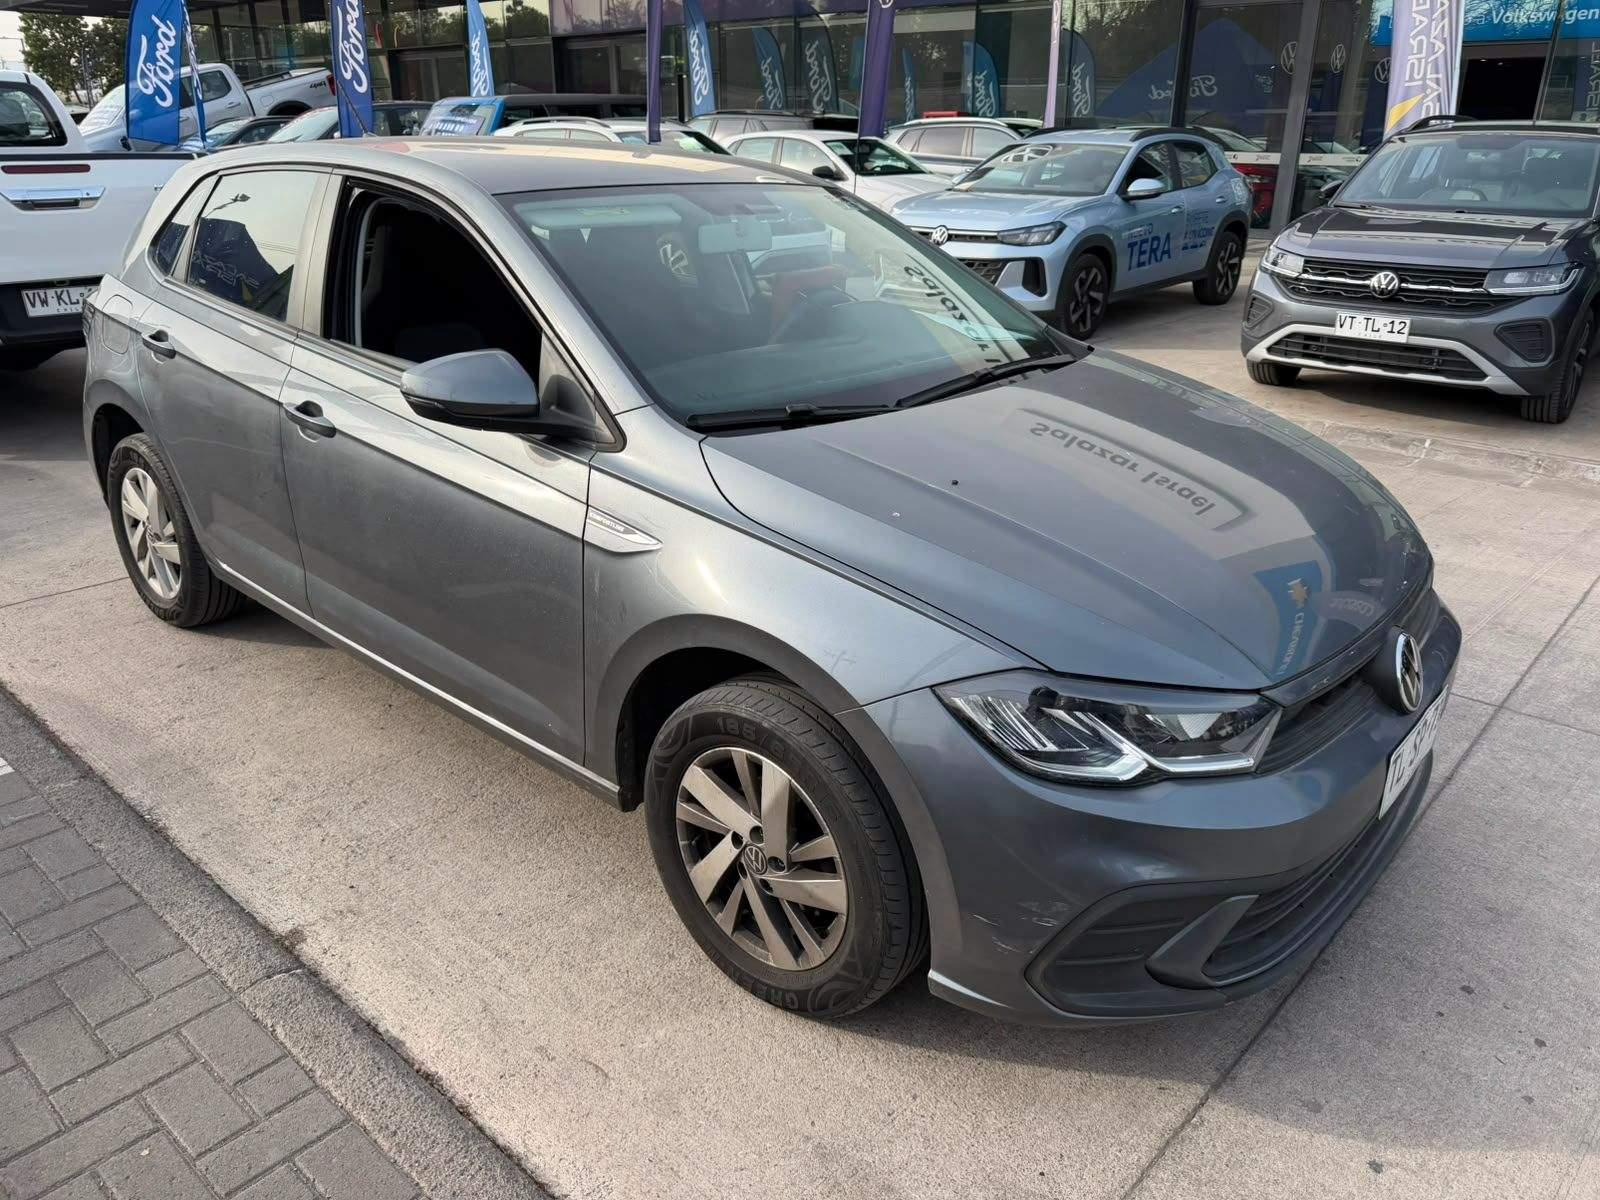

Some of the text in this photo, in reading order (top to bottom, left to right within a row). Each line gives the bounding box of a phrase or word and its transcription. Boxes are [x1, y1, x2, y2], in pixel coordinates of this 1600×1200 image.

[337, 0, 368, 93] Ford
[1491, 8, 1600, 25] Volkswgen
[136, 14, 177, 107] Ford
[1127, 232, 1172, 271] TERA
